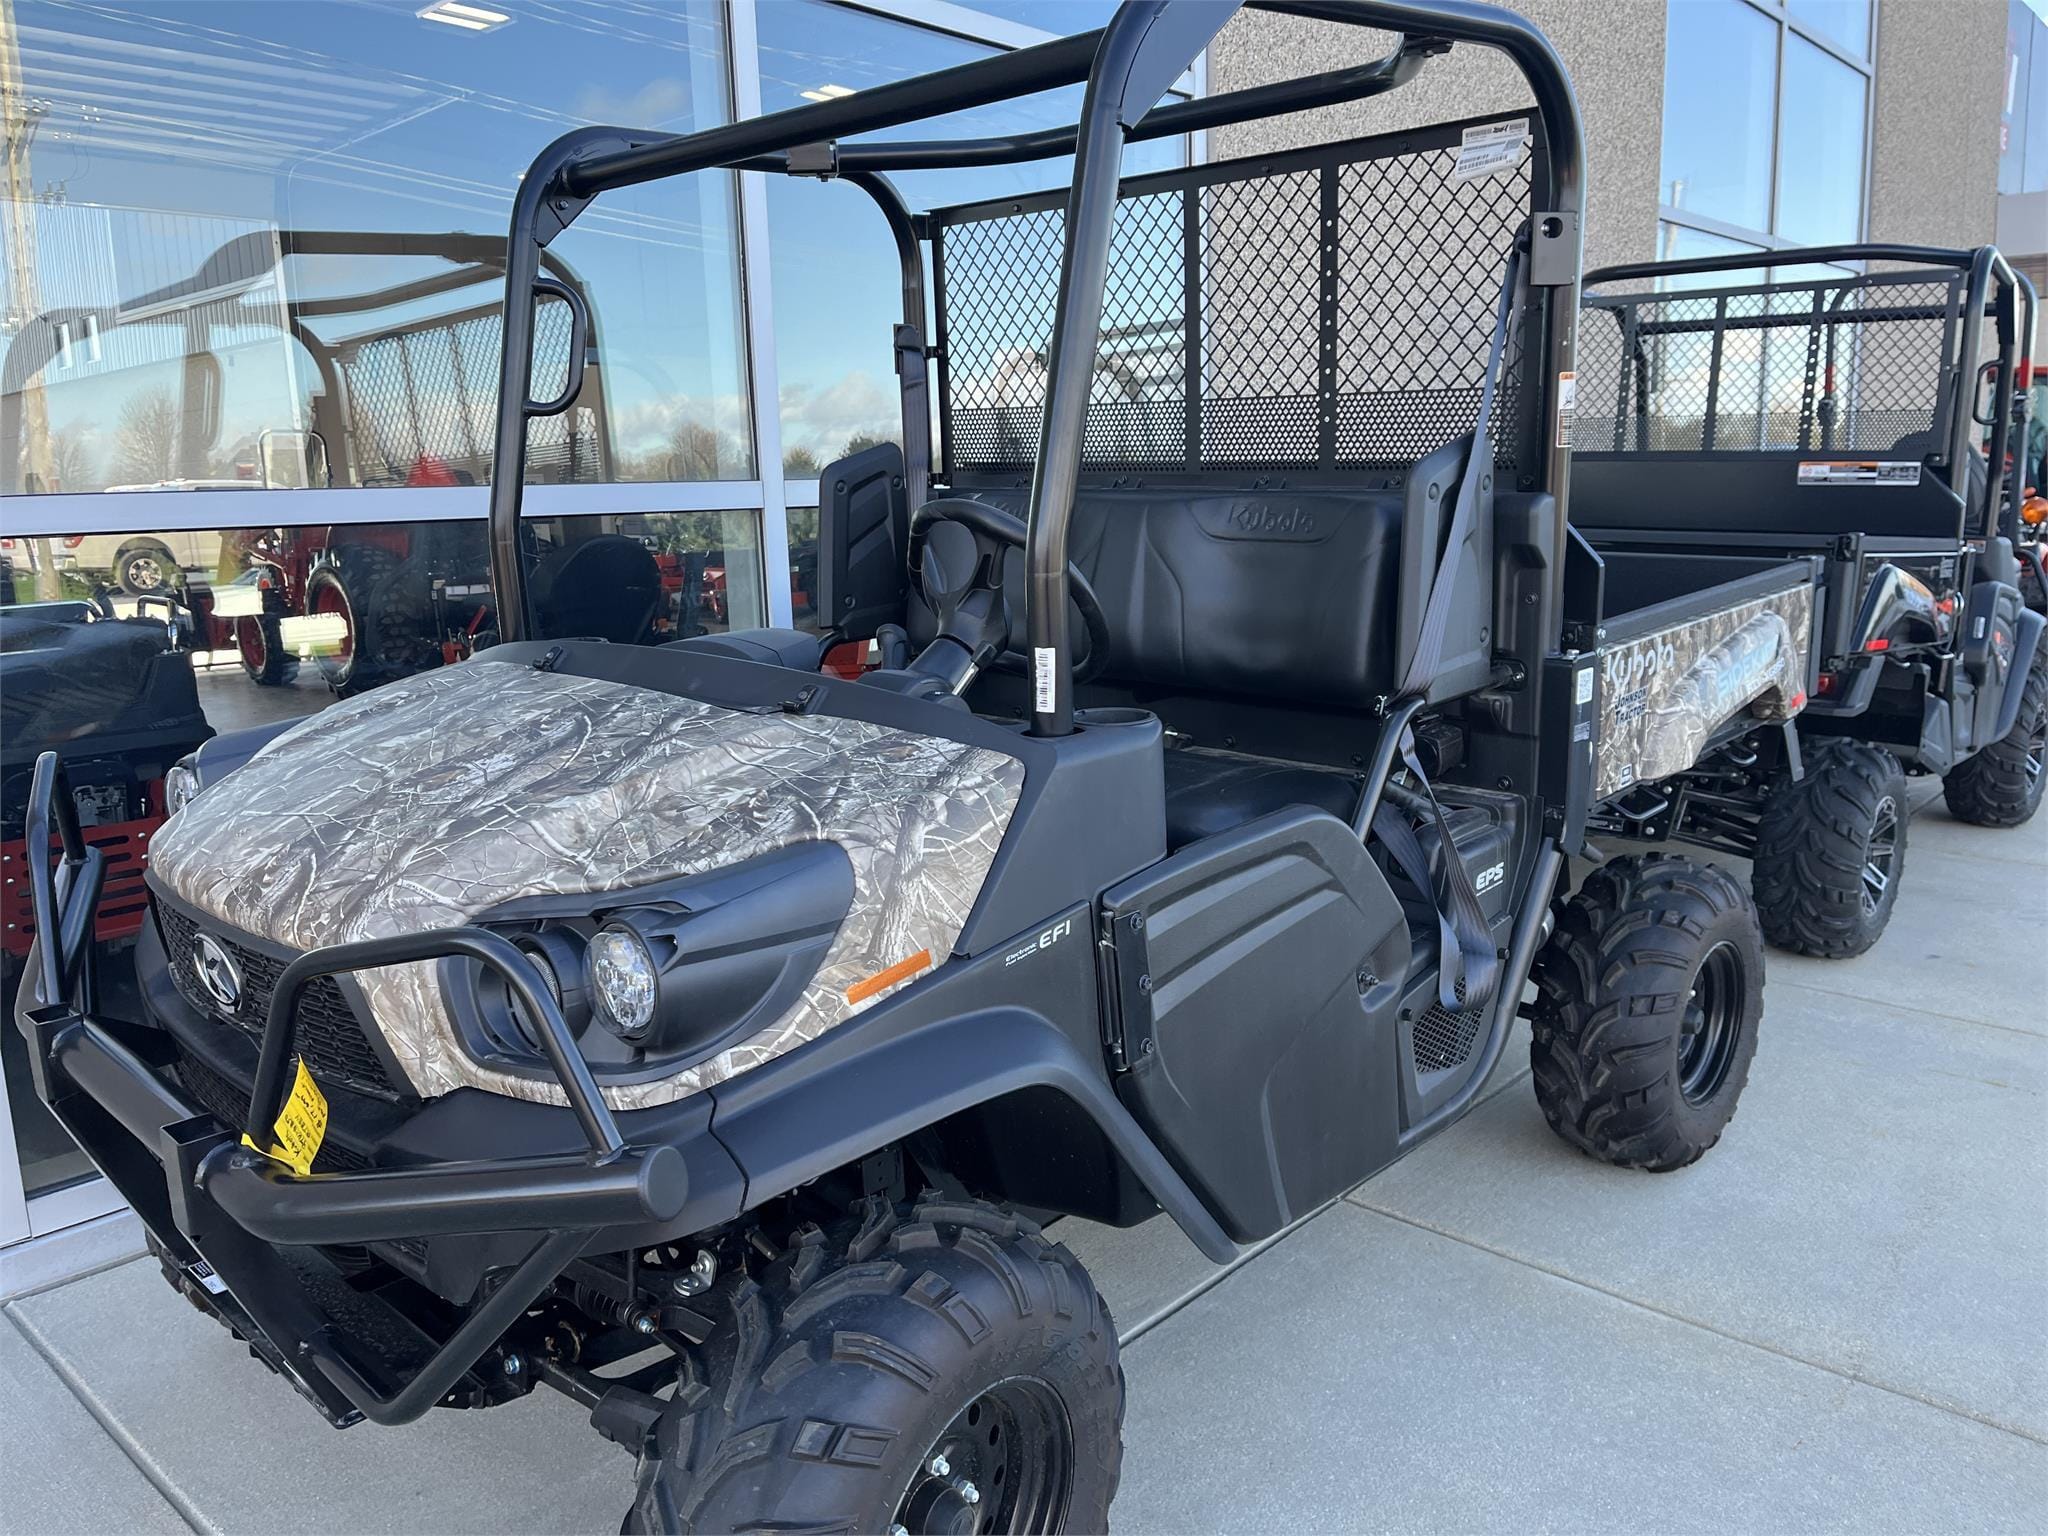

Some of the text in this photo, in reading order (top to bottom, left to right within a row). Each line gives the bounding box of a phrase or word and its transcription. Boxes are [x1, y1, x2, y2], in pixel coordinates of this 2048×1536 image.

[1227, 503, 1313, 532] Kubota
[1606, 636, 1673, 690] Kubota
[1615, 687, 1648, 710] JOHNSON
[1615, 703, 1647, 726] TRACTOR
[1476, 861, 1505, 890] EPS
[1040, 920, 1070, 948] EFI
